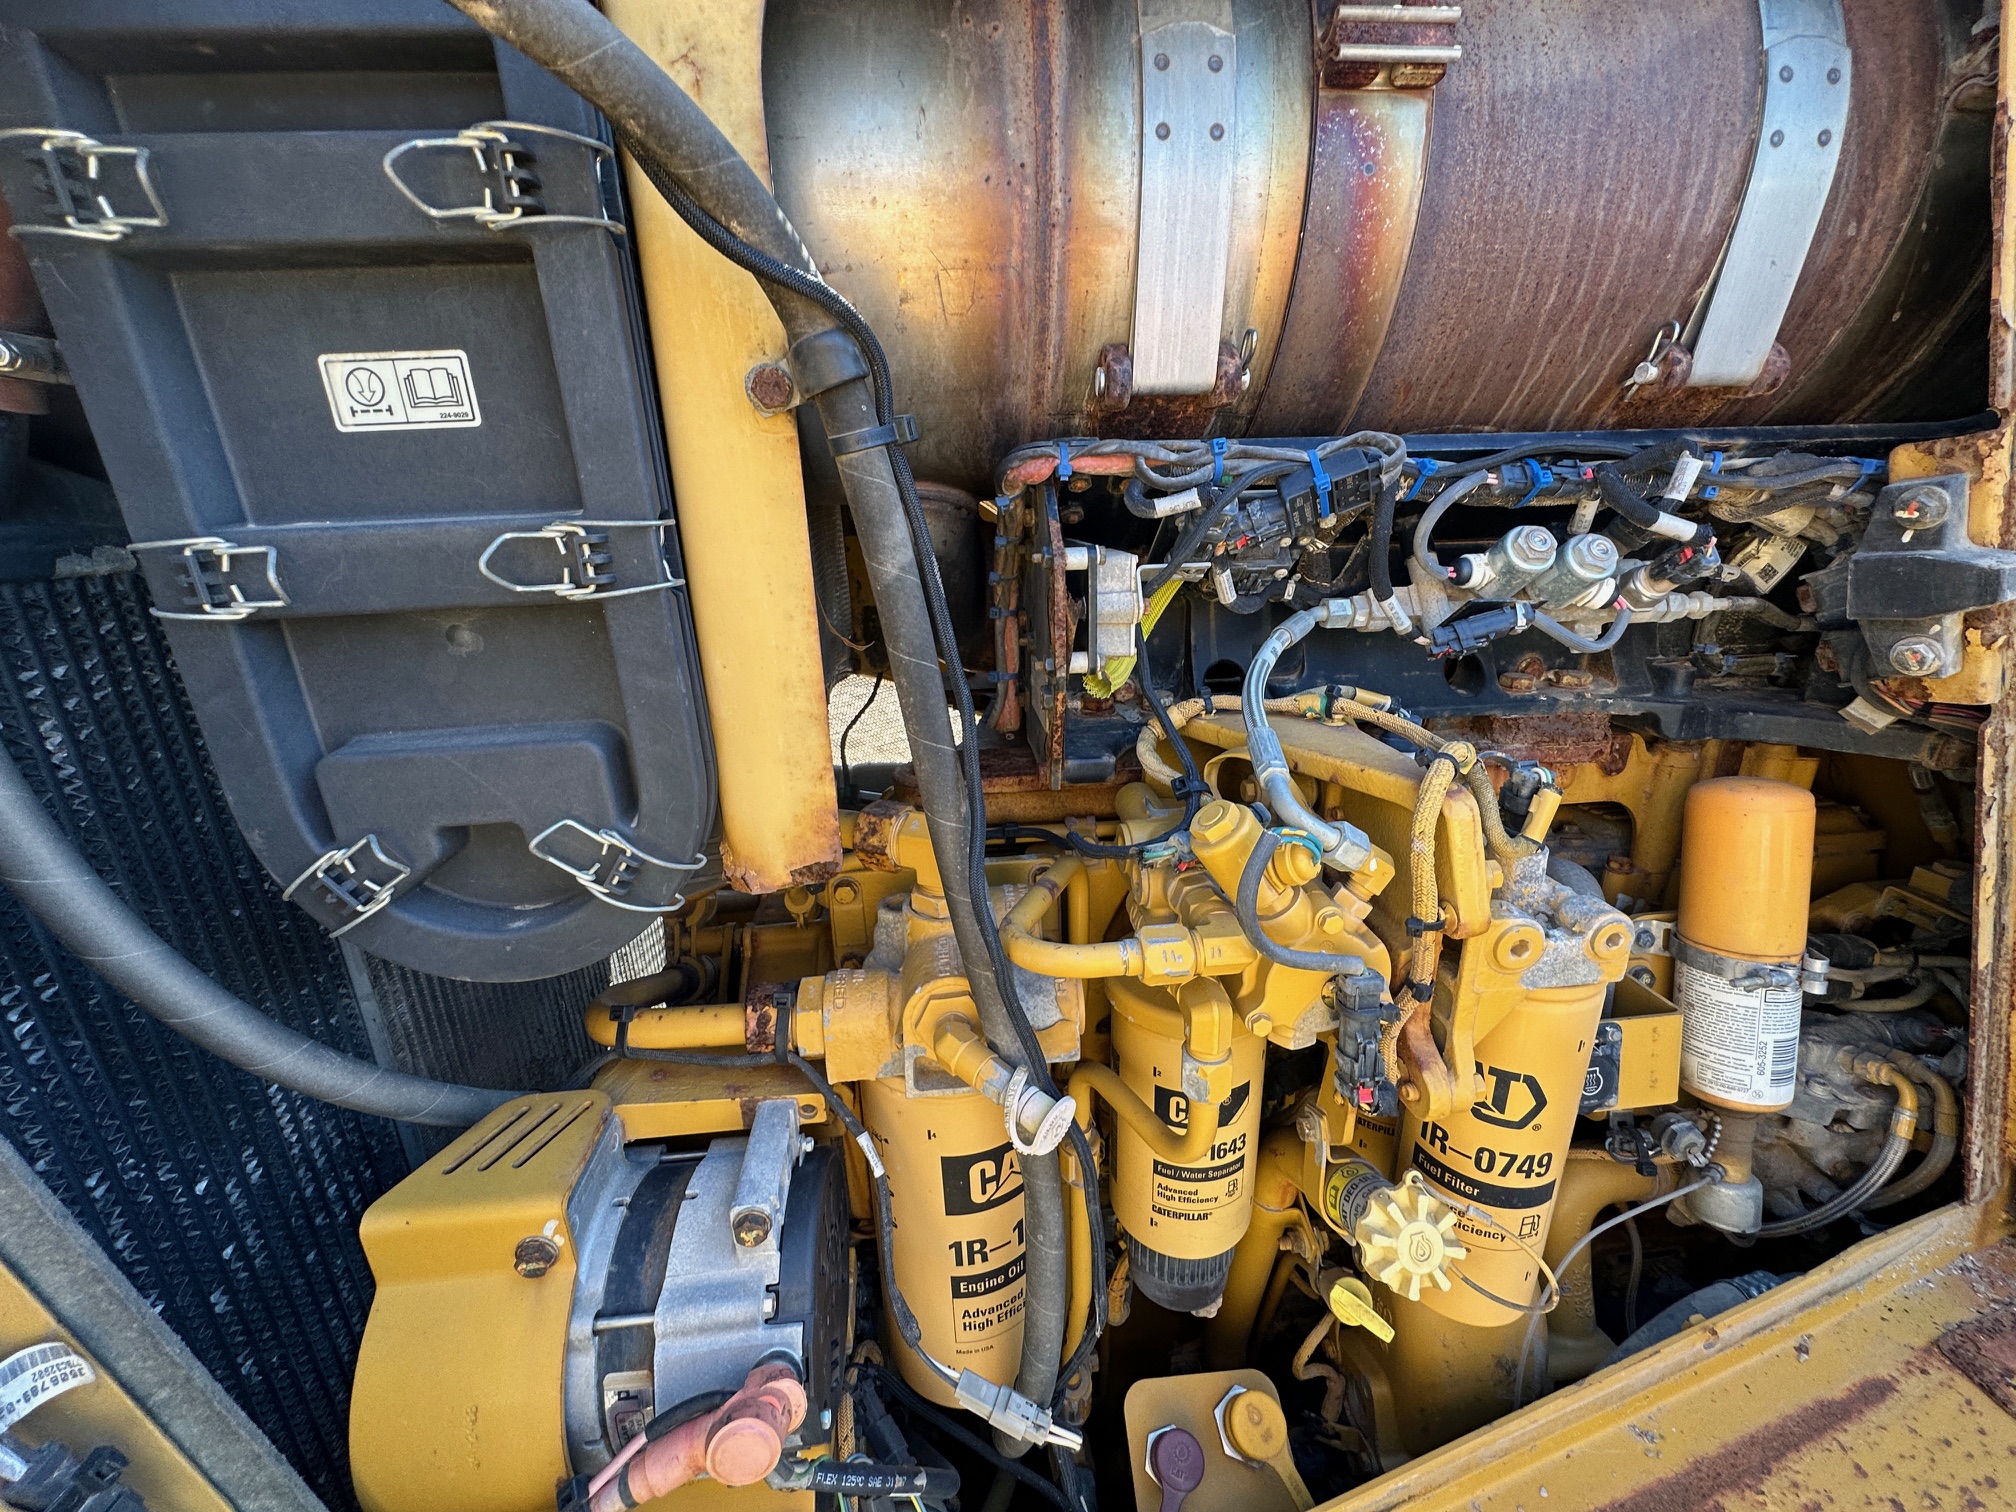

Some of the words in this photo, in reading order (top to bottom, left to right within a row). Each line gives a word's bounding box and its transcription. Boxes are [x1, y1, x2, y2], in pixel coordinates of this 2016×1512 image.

[1756, 1041, 1768, 1076] 605-3252
[1356, 1116, 1396, 1137] ATERPILL
[1210, 1133, 1247, 1161] 1643
[1157, 1164, 1176, 1177] Fuel
[1181, 1170, 1206, 1179] Water
[1208, 1161, 1242, 1178] Separator
[1418, 1153, 1441, 1178] Fuel
[1444, 1172, 1480, 1197] Filter
[1157, 1182, 1199, 1196] Advanced
[1157, 1190, 1176, 1203] High
[1178, 1196, 1219, 1204] Efficiency
[948, 1217, 1025, 1267] 1R-1
[1452, 1220, 1507, 1243] iciency
[960, 1274, 1005, 1293] Engine
[1008, 1260, 1024, 1277] Oil
[962, 1288, 1024, 1320] Advanced
[963, 1317, 993, 1332] High
[997, 1301, 1026, 1324] Effici
[981, 1345, 994, 1353] USA
[816, 1472, 838, 1486] FLEX
[868, 1476, 882, 1488] SAE
